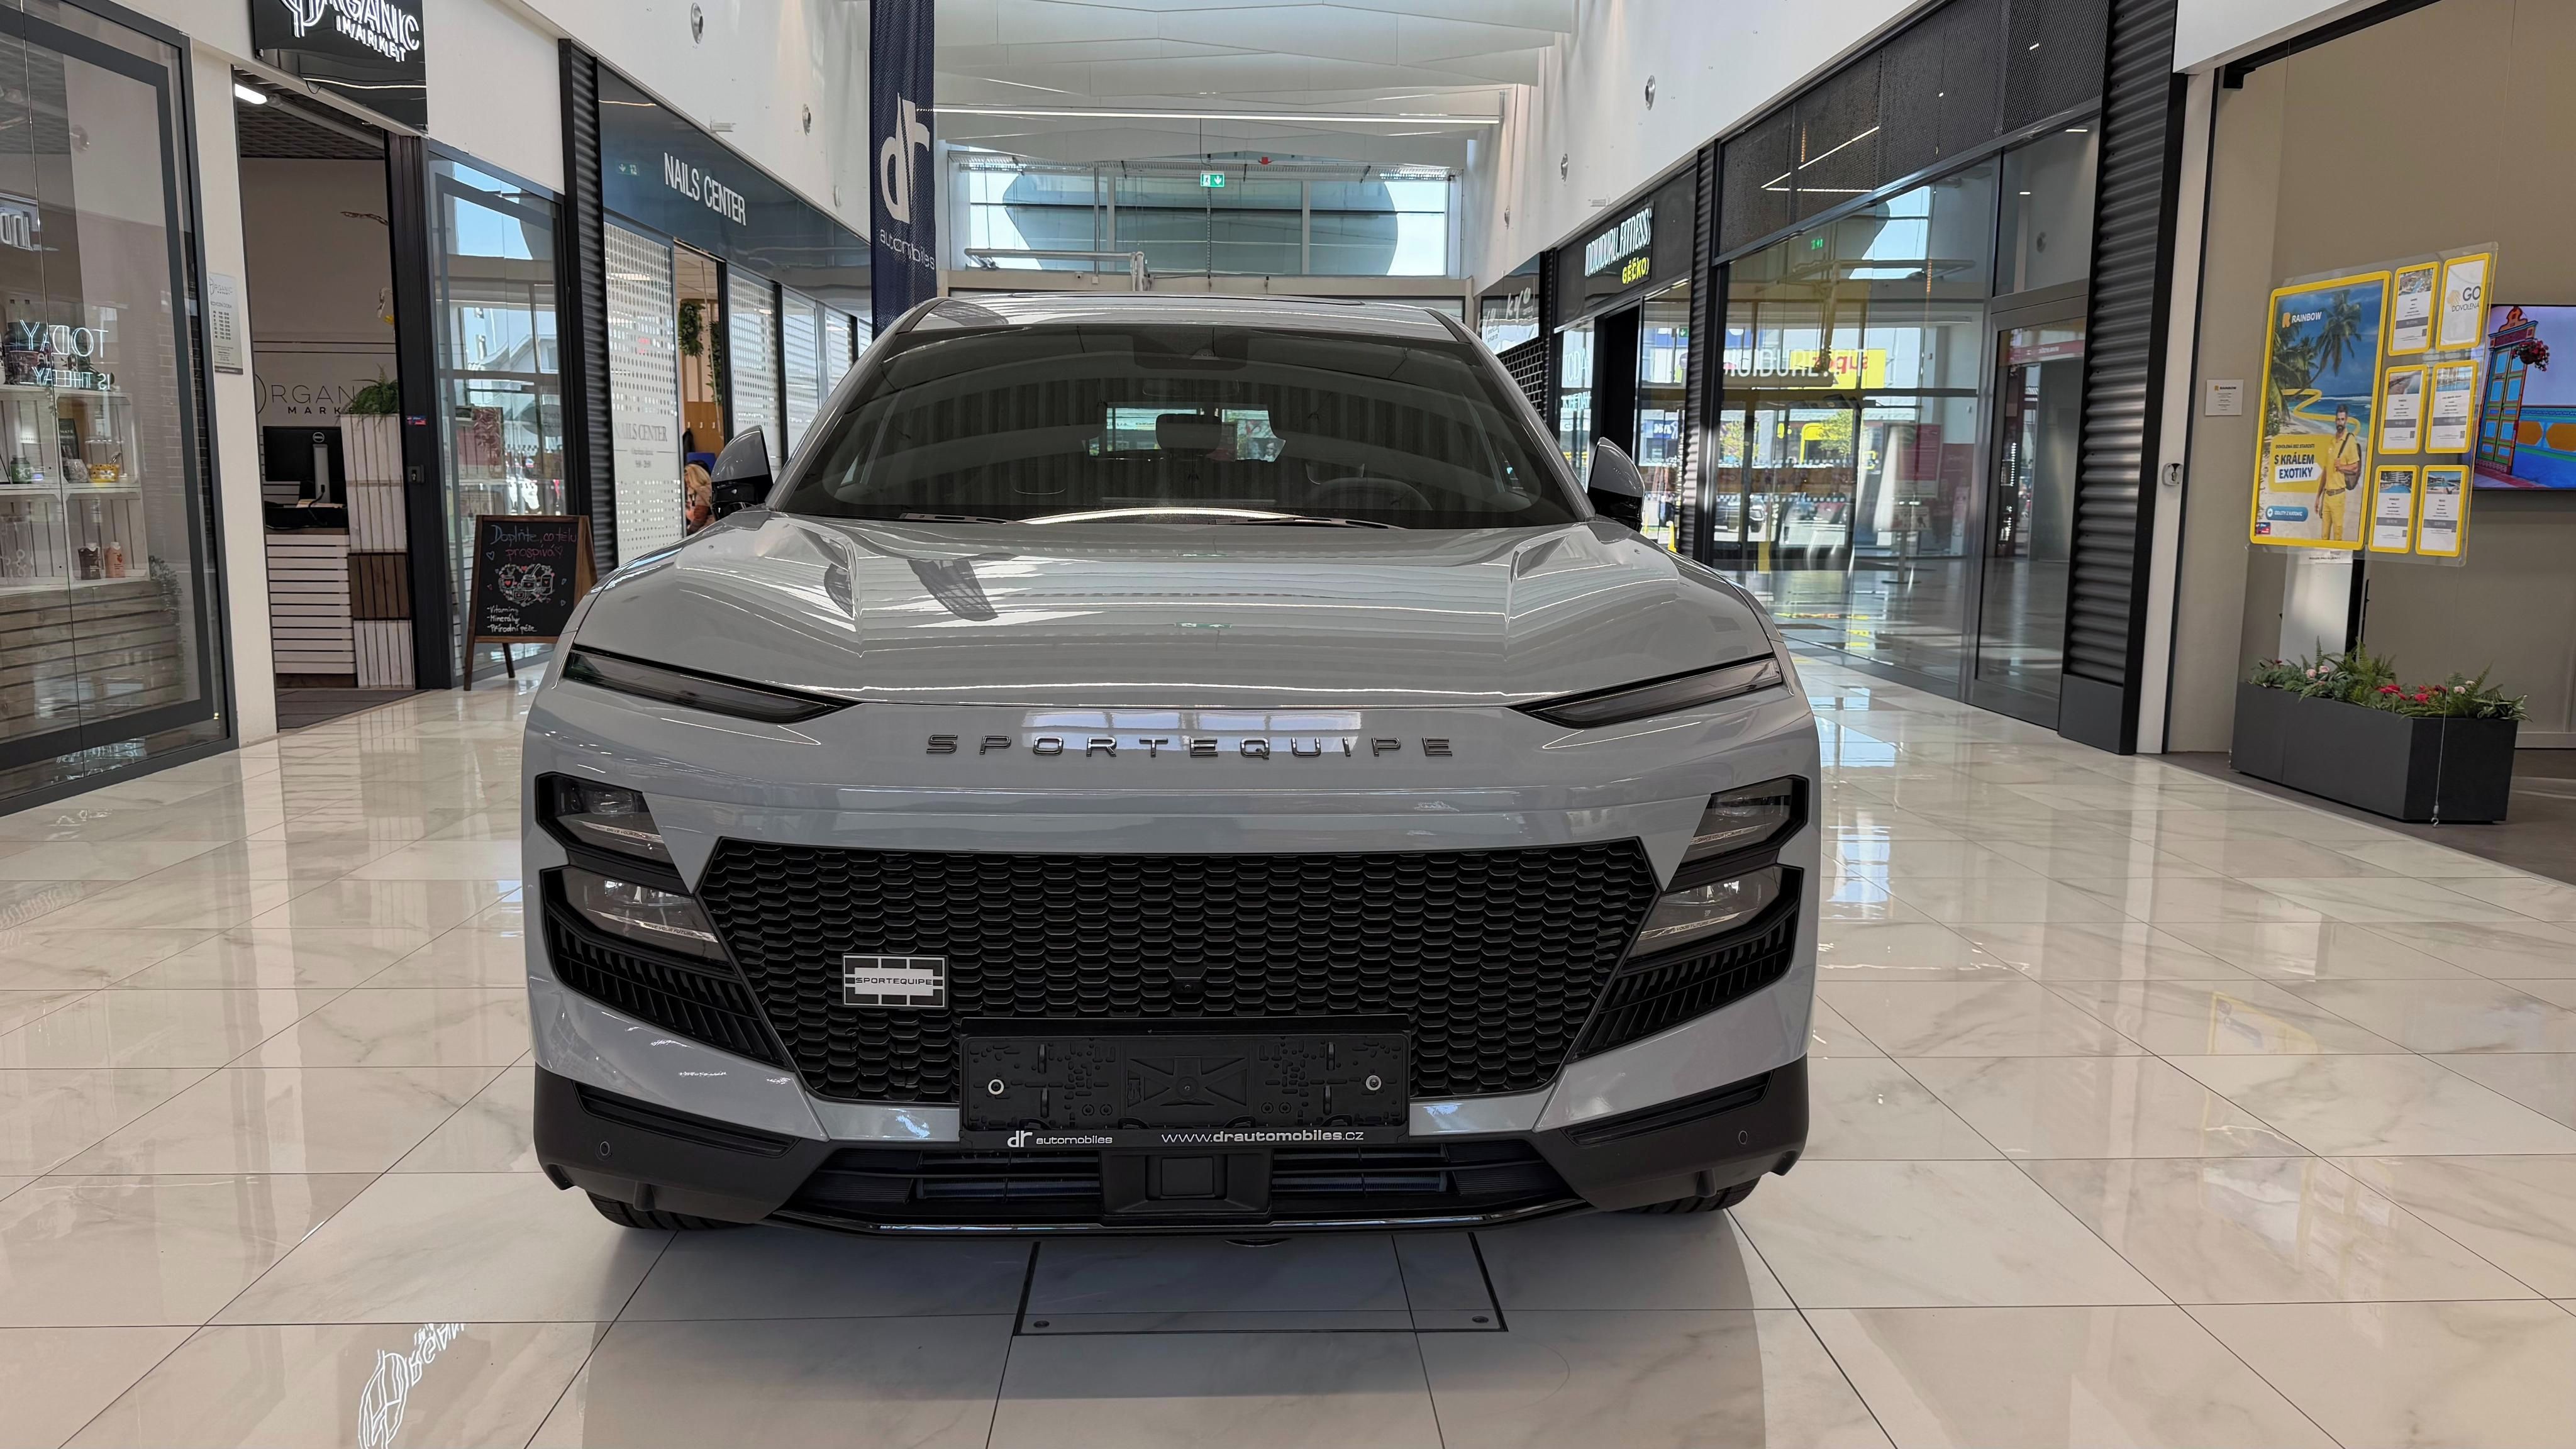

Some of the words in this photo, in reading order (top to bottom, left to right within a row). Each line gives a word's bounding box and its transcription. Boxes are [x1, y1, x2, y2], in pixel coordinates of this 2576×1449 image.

[664, 152, 700, 201] NAILS
[704, 175, 747, 226] CENTER
[880, 229, 935, 270] automobiles
[2462, 286, 2482, 302] GO
[2292, 311, 2322, 324] RAINBOW
[255, 374, 356, 414] RGAN
[287, 406, 354, 414] MARKE
[2274, 455, 2279, 465] S
[2281, 452, 2314, 465] KRÁLEM
[2279, 467, 2313, 479] EXOTIKY
[926, 734, 1453, 760] SPORTEQUIPE
[855, 977, 933, 985] SPORTEQUIPE
[1007, 1130, 1033, 1148] dr
[1036, 1135, 1113, 1145] automobiles
[1162, 1130, 1364, 1143] www.drautomobiles.cz
